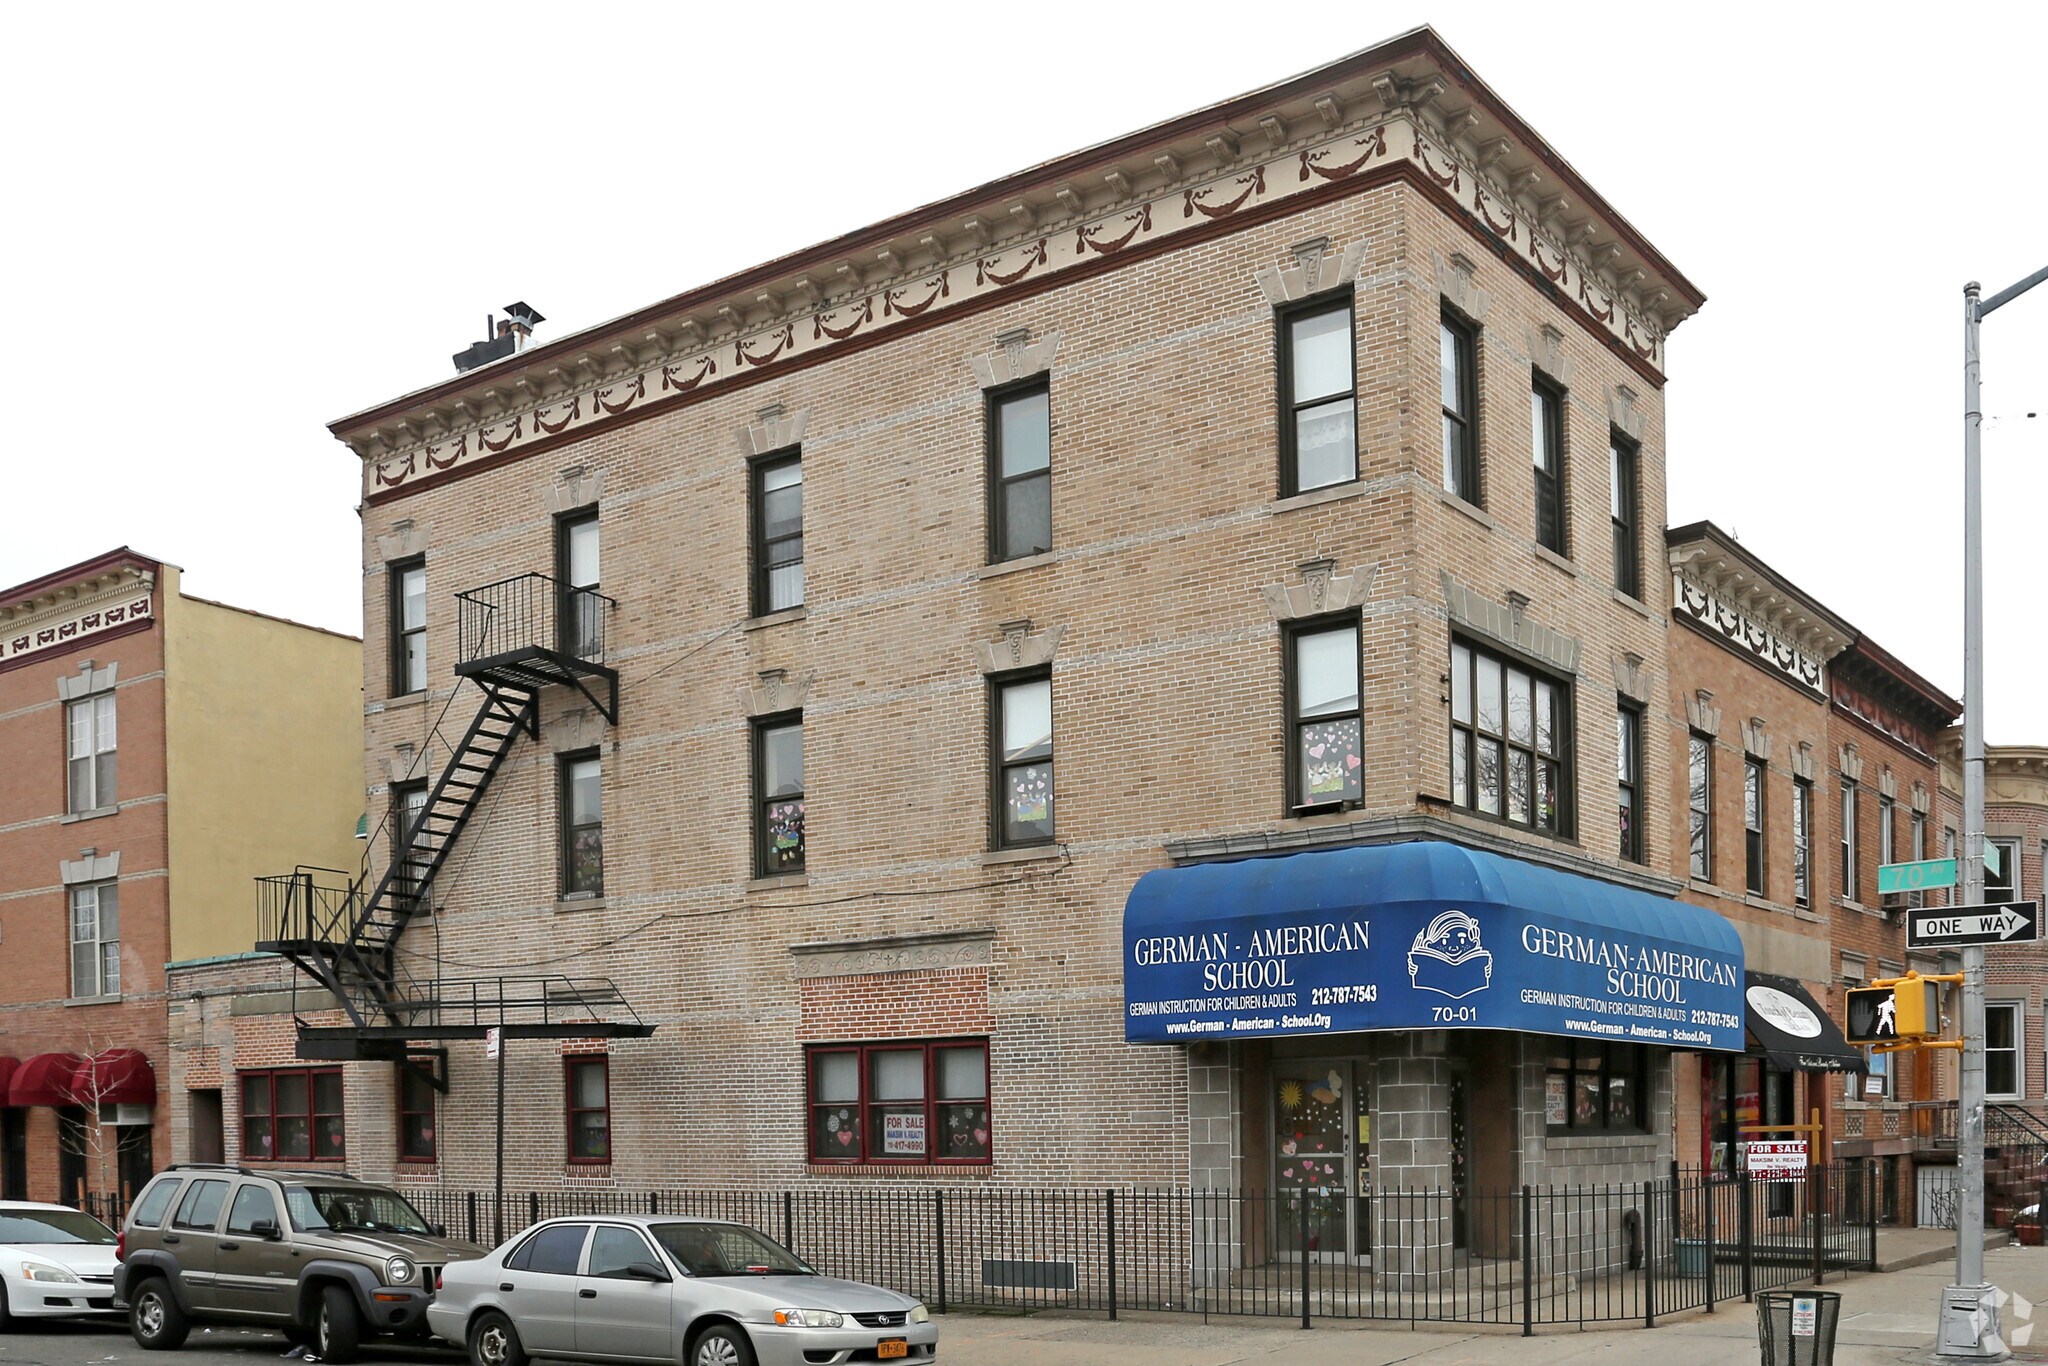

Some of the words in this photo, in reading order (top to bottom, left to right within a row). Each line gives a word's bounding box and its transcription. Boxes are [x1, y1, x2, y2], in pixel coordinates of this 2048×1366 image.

[1891, 864, 1924, 889] 70
[1926, 918, 1962, 935] ONE
[1980, 915, 2017, 932] WAY
[1134, 932, 1228, 966] GERMAN
[1248, 921, 1370, 957] AMERICAN
[1203, 959, 1295, 992] SCHOOL
[1311, 985, 1377, 1005] 212-787-7543
[1606, 968, 1687, 1004] SCHOOL
[1129, 1001, 1158, 1017] GERMAN
[1159, 998, 1206, 1014] INSTRUCTION
[1207, 997, 1223, 1011] FOR
[1223, 995, 1261, 1010] CHILDREN
[1261, 995, 1268, 1008] &
[1268, 993, 1297, 1008] ADULTS
[1432, 1006, 1477, 1022] 70-01
[1520, 988, 1557, 1006] GERMAN
[1558, 993, 1607, 1014] INSTRUCTION
[1608, 1001, 1623, 1015] FOR
[1623, 1003, 1657, 1019] CHILDREN
[1657, 1007, 1662, 1019] &
[1662, 1008, 1687, 1022] ADULTS
[1231, 1017, 1274, 1031] American
[1281, 1013, 1331, 1029] School.Org
[1691, 1009, 1739, 1029] 212-787-7543
[1630, 1024, 1667, 1039] American
[1673, 1028, 1712, 1045] School.Org
[886, 1117, 902, 1128] FOR
[905, 1117, 924, 1128] SALE
[1750, 1144, 1772, 1154] FOR
[1776, 1144, 1805, 1153] SALE
